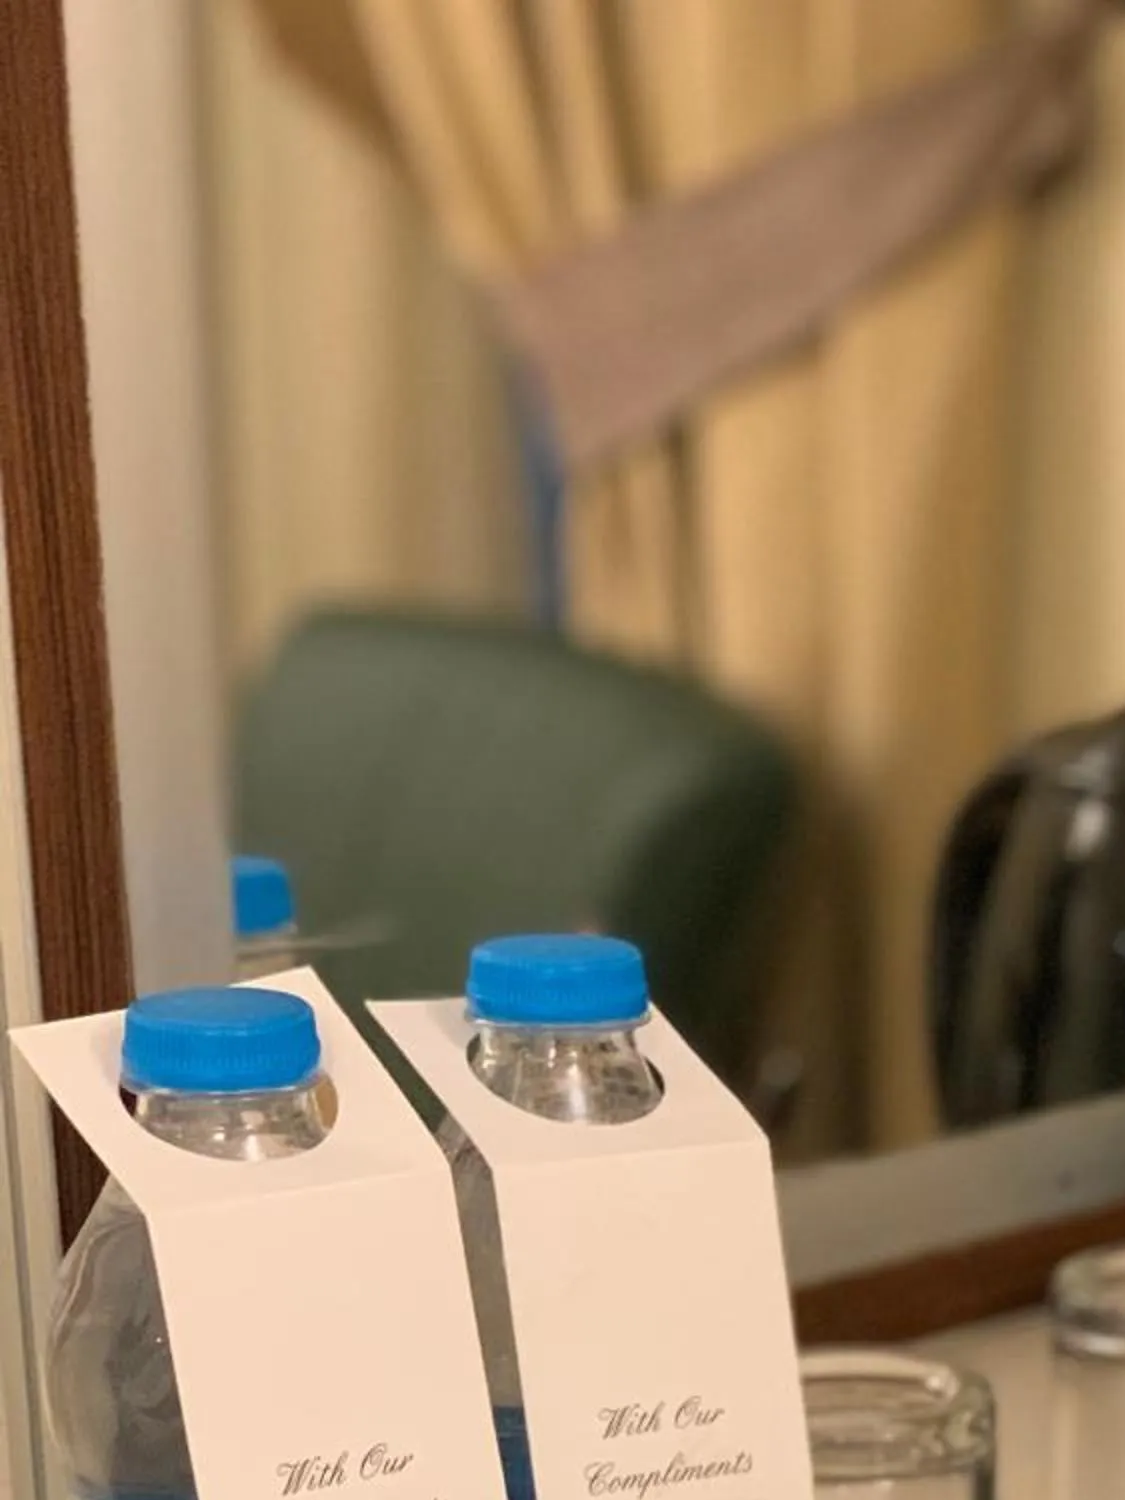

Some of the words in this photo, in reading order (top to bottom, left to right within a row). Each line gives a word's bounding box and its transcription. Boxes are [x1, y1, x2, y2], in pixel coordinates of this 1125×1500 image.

[598, 1403, 662, 1441] With
[673, 1395, 725, 1430] Our
[275, 1454, 348, 1497] With
[358, 1442, 414, 1480] Our
[584, 1450, 754, 1500] Compliments
